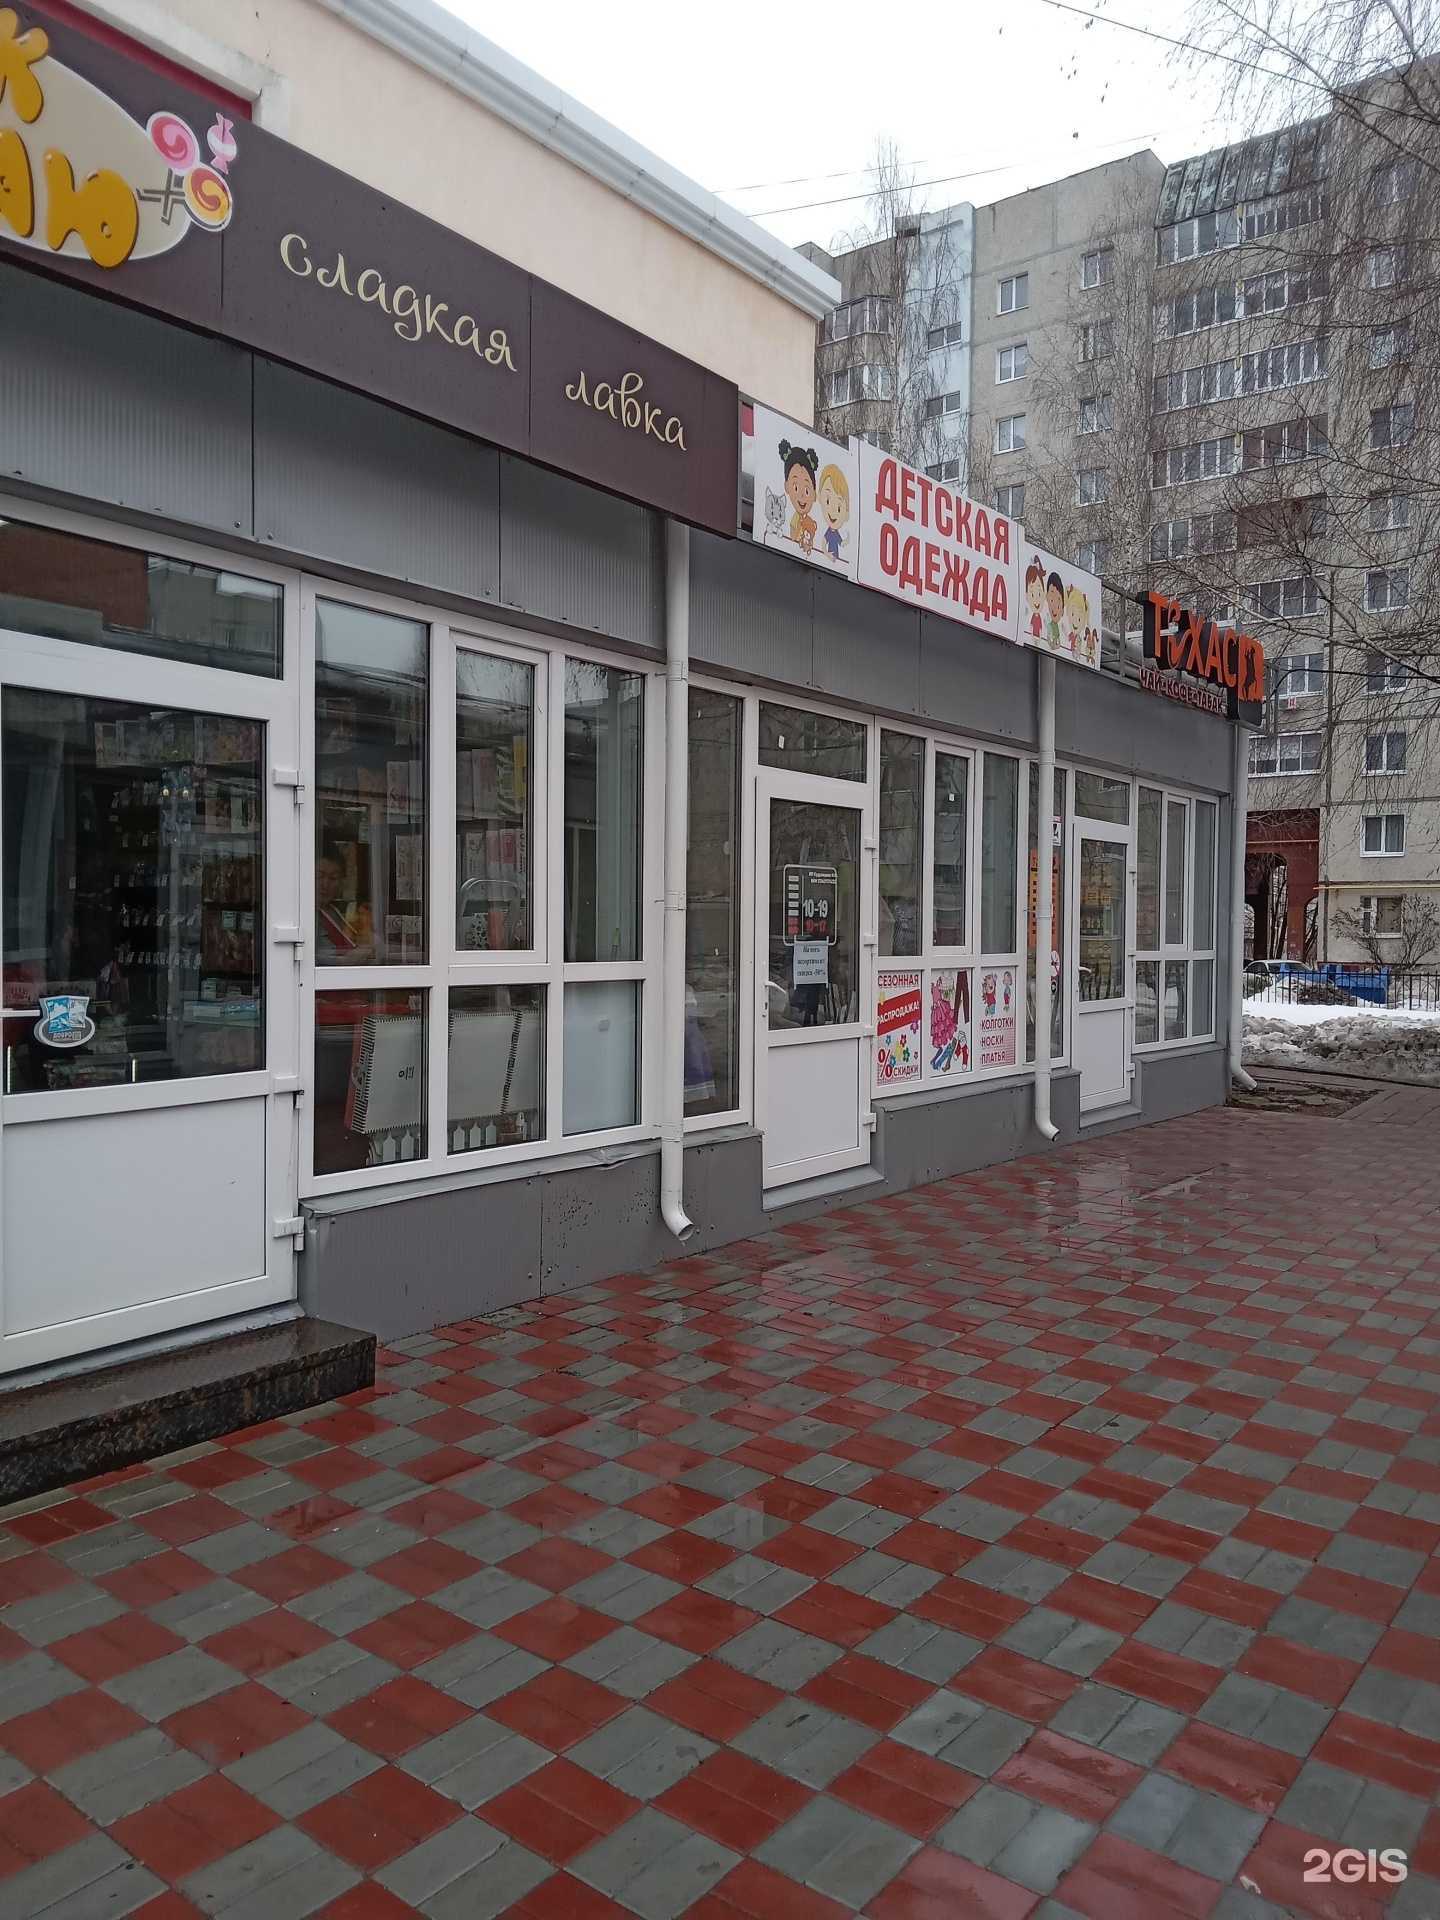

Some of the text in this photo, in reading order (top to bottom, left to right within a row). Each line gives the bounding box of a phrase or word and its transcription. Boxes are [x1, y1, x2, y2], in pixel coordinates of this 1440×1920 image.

[565, 372, 688, 452] лавка
[875, 458, 1010, 566] ДЕТСКАЯ
[879, 523, 1009, 622] ОДЕЖДА
[803, 899, 829, 918] 10-19
[878, 974, 919, 987] СЕЗОННАЯ
[981, 1017, 1014, 1031] КОЛГОТКИ
[981, 1035, 1004, 1048] НОСКИ
[981, 1051, 1006, 1065] ПЛАТЬЯ
[893, 1064, 919, 1077] СКИДКИ
